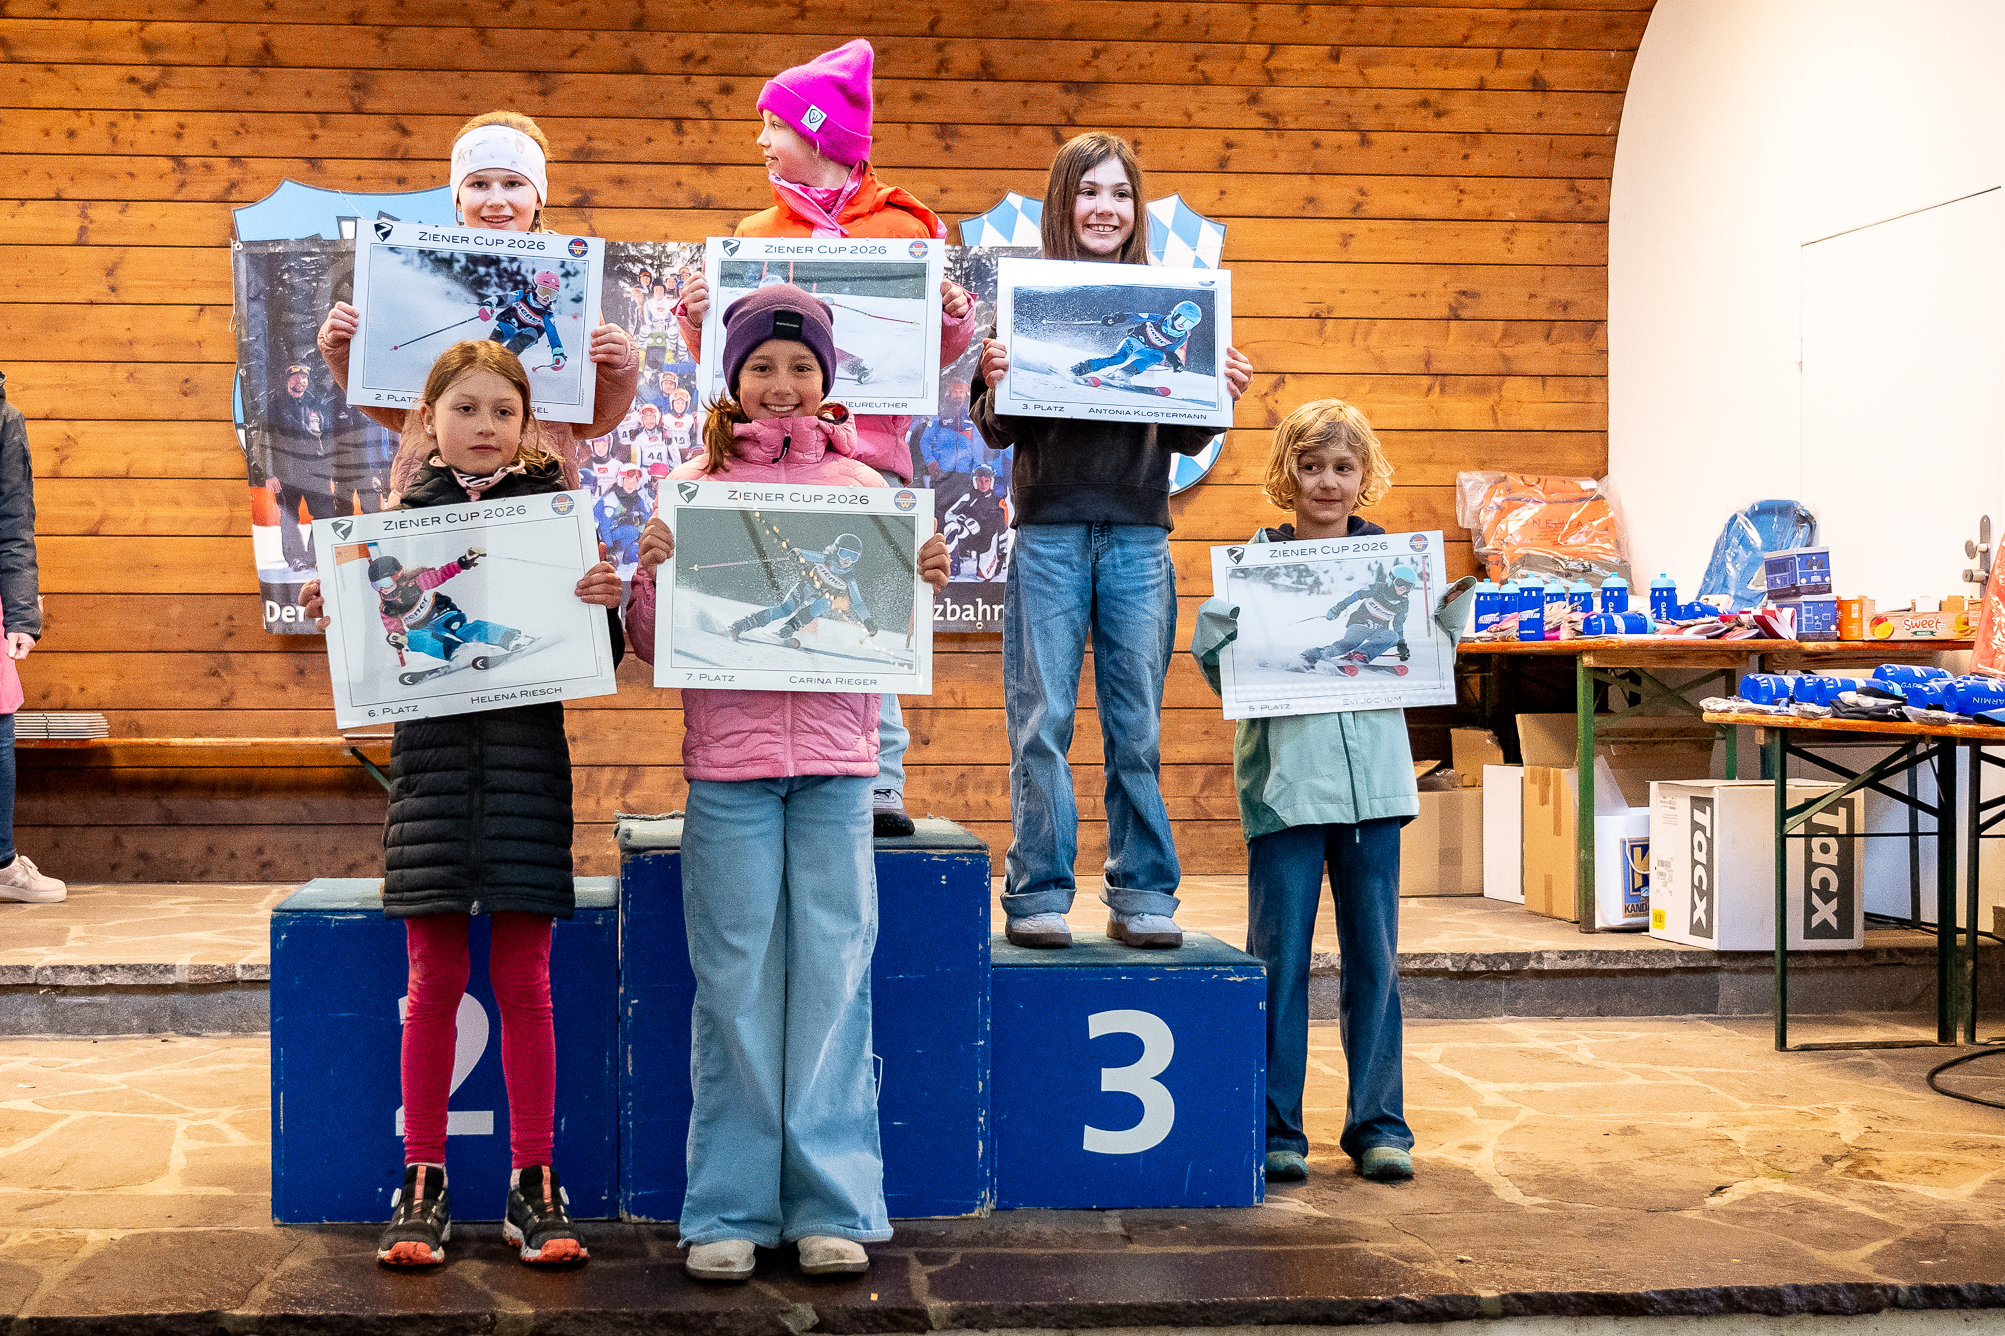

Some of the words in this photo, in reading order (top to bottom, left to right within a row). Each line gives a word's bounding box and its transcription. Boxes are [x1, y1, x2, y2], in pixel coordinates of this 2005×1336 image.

[418, 231, 470, 245] ZIENER
[473, 235, 505, 248] CUP
[506, 238, 546, 251] 2026
[764, 244, 814, 254] ZIENER
[817, 245, 847, 255] CUP
[849, 245, 887, 255] 2026
[375, 393, 385, 401] 2.
[1022, 403, 1031, 411] 3.
[1033, 404, 1065, 412] PLATZ
[1087, 407, 1132, 416] ANTONIA
[1133, 409, 1207, 420] KLOSTERMANN
[727, 489, 785, 502] ZIENER
[789, 492, 824, 504] CUP
[826, 493, 870, 505] 2026
[382, 516, 441, 531] ZIENER
[445, 511, 480, 524] CUP
[483, 504, 527, 519] 2026
[1269, 548, 1317, 558] ZIENER
[1320, 545, 1350, 555] CUP
[1352, 541, 1389, 553] 2026
[266, 600, 306, 623] Der
[685, 673, 696, 681] 7.
[699, 673, 735, 683] PLATZ
[789, 675, 833, 686] CARINA
[835, 676, 878, 687] RIEGER
[470, 691, 518, 705] HELENA
[519, 686, 563, 698] RIESCH
[368, 709, 380, 718] 6.
[382, 704, 419, 716] PLATZ
[1260, 703, 1291, 712] PLATZ
[1692, 805, 1711, 930] Tacx
[1811, 806, 1848, 931] Tacx
[1082, 1009, 1176, 1155] 3
